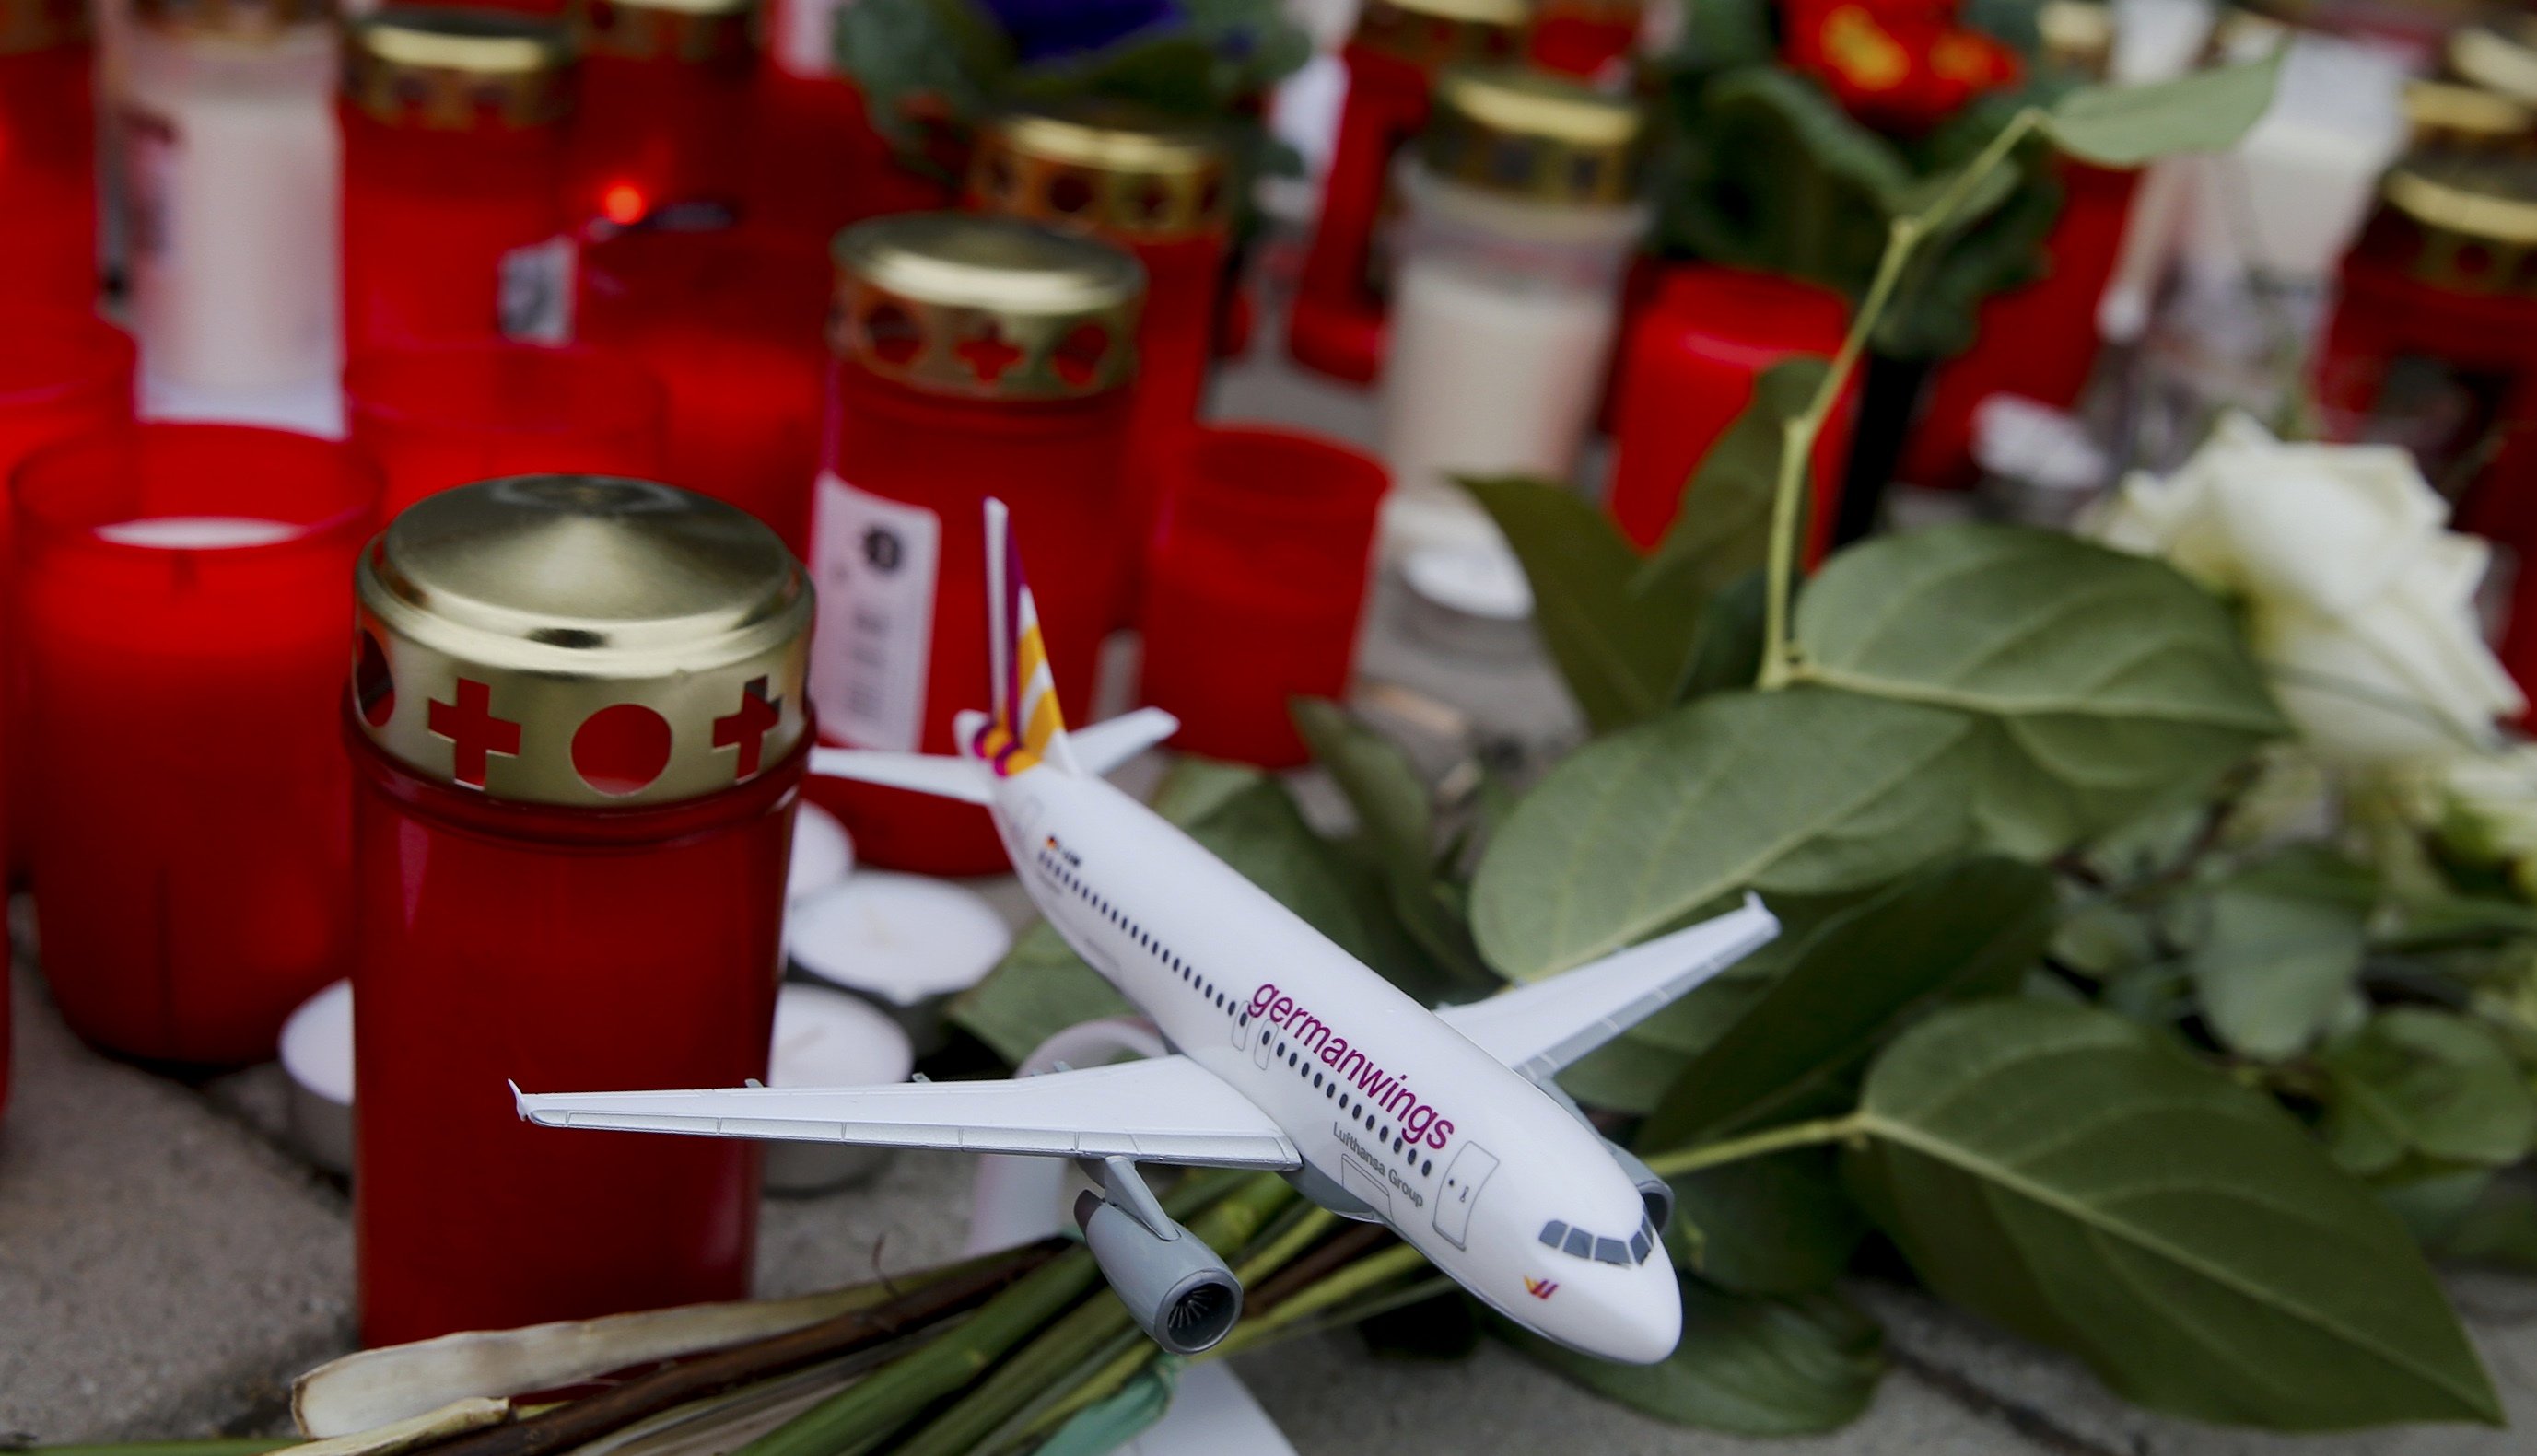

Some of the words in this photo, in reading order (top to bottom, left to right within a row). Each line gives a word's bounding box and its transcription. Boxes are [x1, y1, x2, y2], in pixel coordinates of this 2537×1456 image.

[1247, 984, 1455, 1149] germanwings
[1333, 1121, 1385, 1177] Lufthansa
[1388, 1168, 1424, 1208] Group
